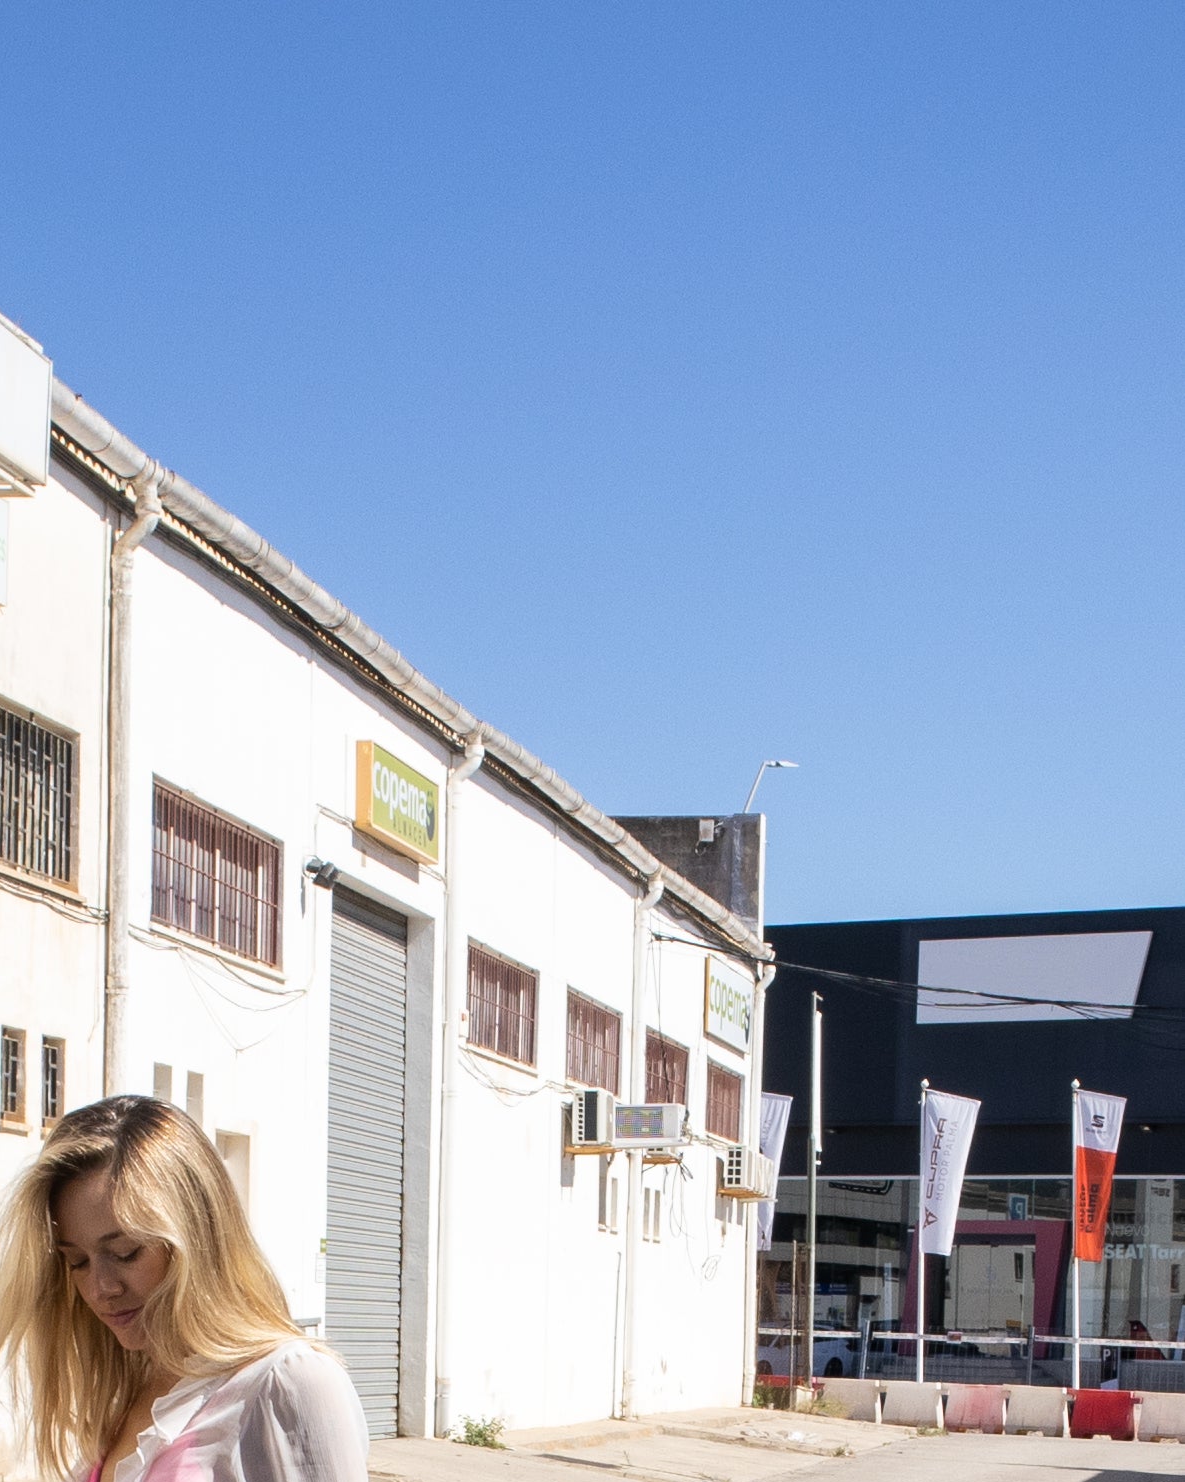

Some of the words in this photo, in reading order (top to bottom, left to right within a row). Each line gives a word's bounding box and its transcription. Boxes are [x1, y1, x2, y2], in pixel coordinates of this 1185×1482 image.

[926, 1117, 947, 1199] CUPRA
[943, 1120, 959, 1158] PALMA
[936, 1160, 951, 1201] MOTOR
[1106, 1222, 1151, 1238] Nuevo
[1104, 1244, 1147, 1260] SEAT
